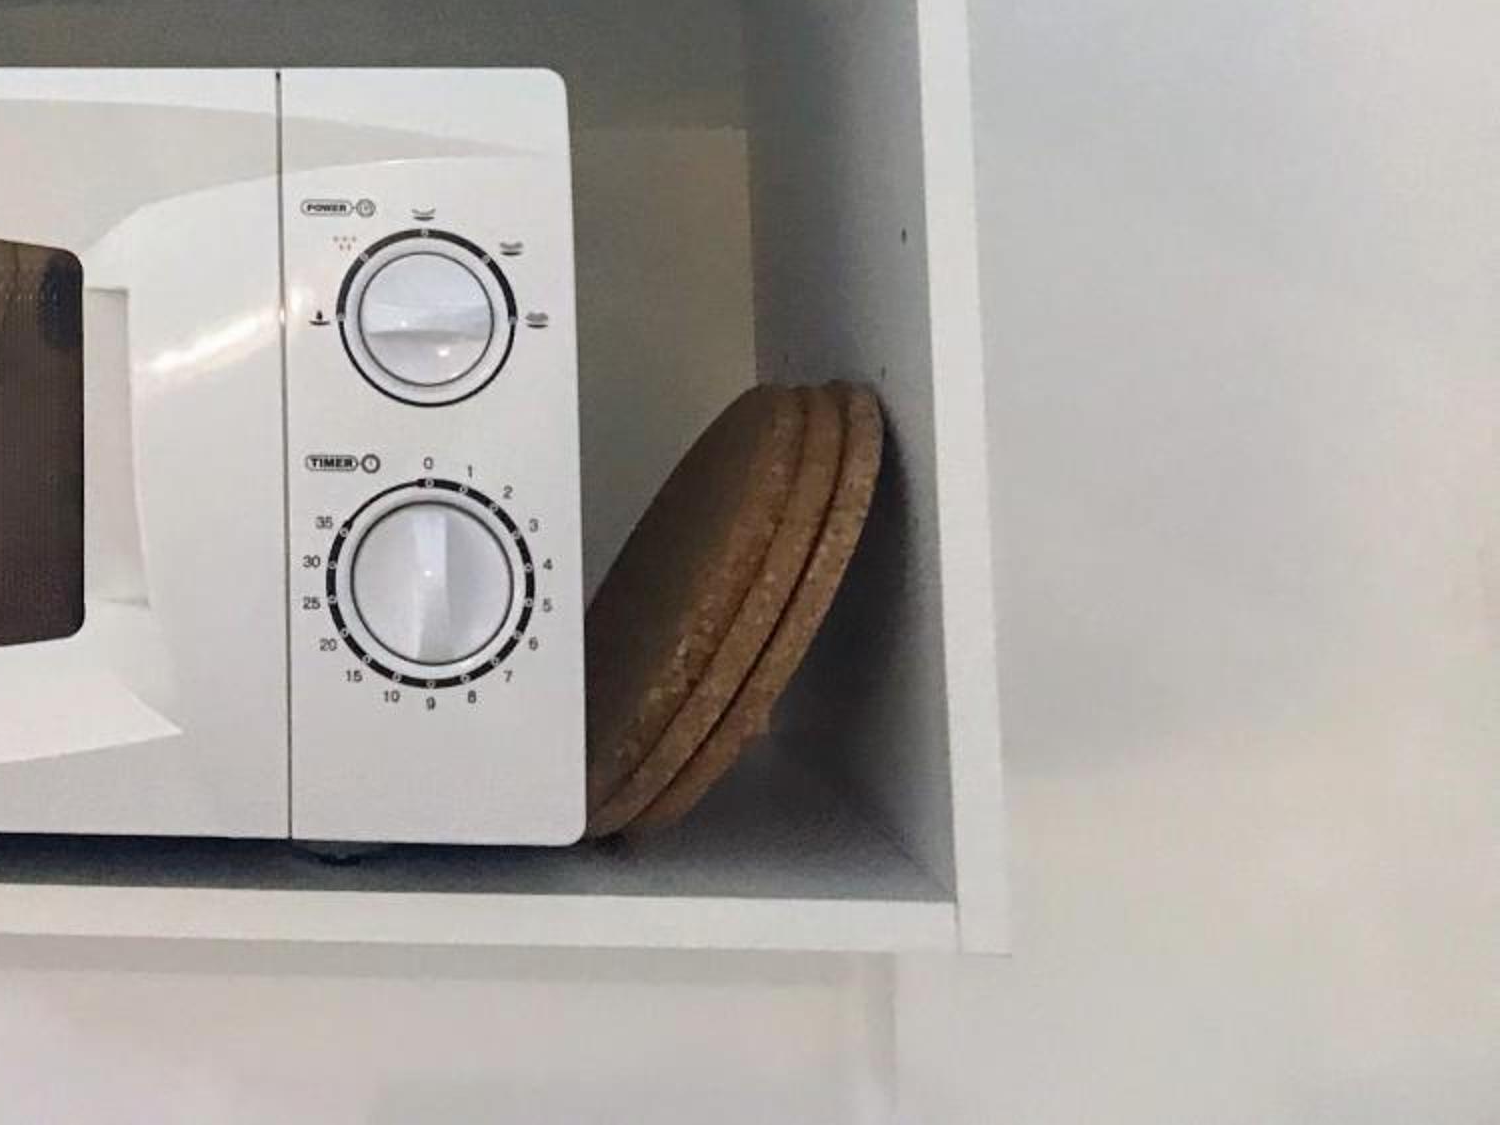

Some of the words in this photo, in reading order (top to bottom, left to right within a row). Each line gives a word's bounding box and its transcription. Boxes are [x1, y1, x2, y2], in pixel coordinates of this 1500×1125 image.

[306, 203, 347, 212] POWER
[310, 457, 353, 468] TIMER
[424, 457, 433, 470] 0
[503, 486, 513, 498] 2
[316, 517, 333, 529] 35
[528, 519, 538, 532] 3
[302, 556, 321, 568] 30
[542, 558, 552, 570] 4
[302, 597, 321, 610] 25
[542, 599, 552, 612] 5
[319, 638, 337, 651] 20
[529, 638, 538, 650] 6
[345, 670, 362, 683] 15
[503, 671, 513, 683] 7
[383, 690, 400, 702] 10
[467, 691, 477, 704] 8
[426, 696, 436, 710] 9
